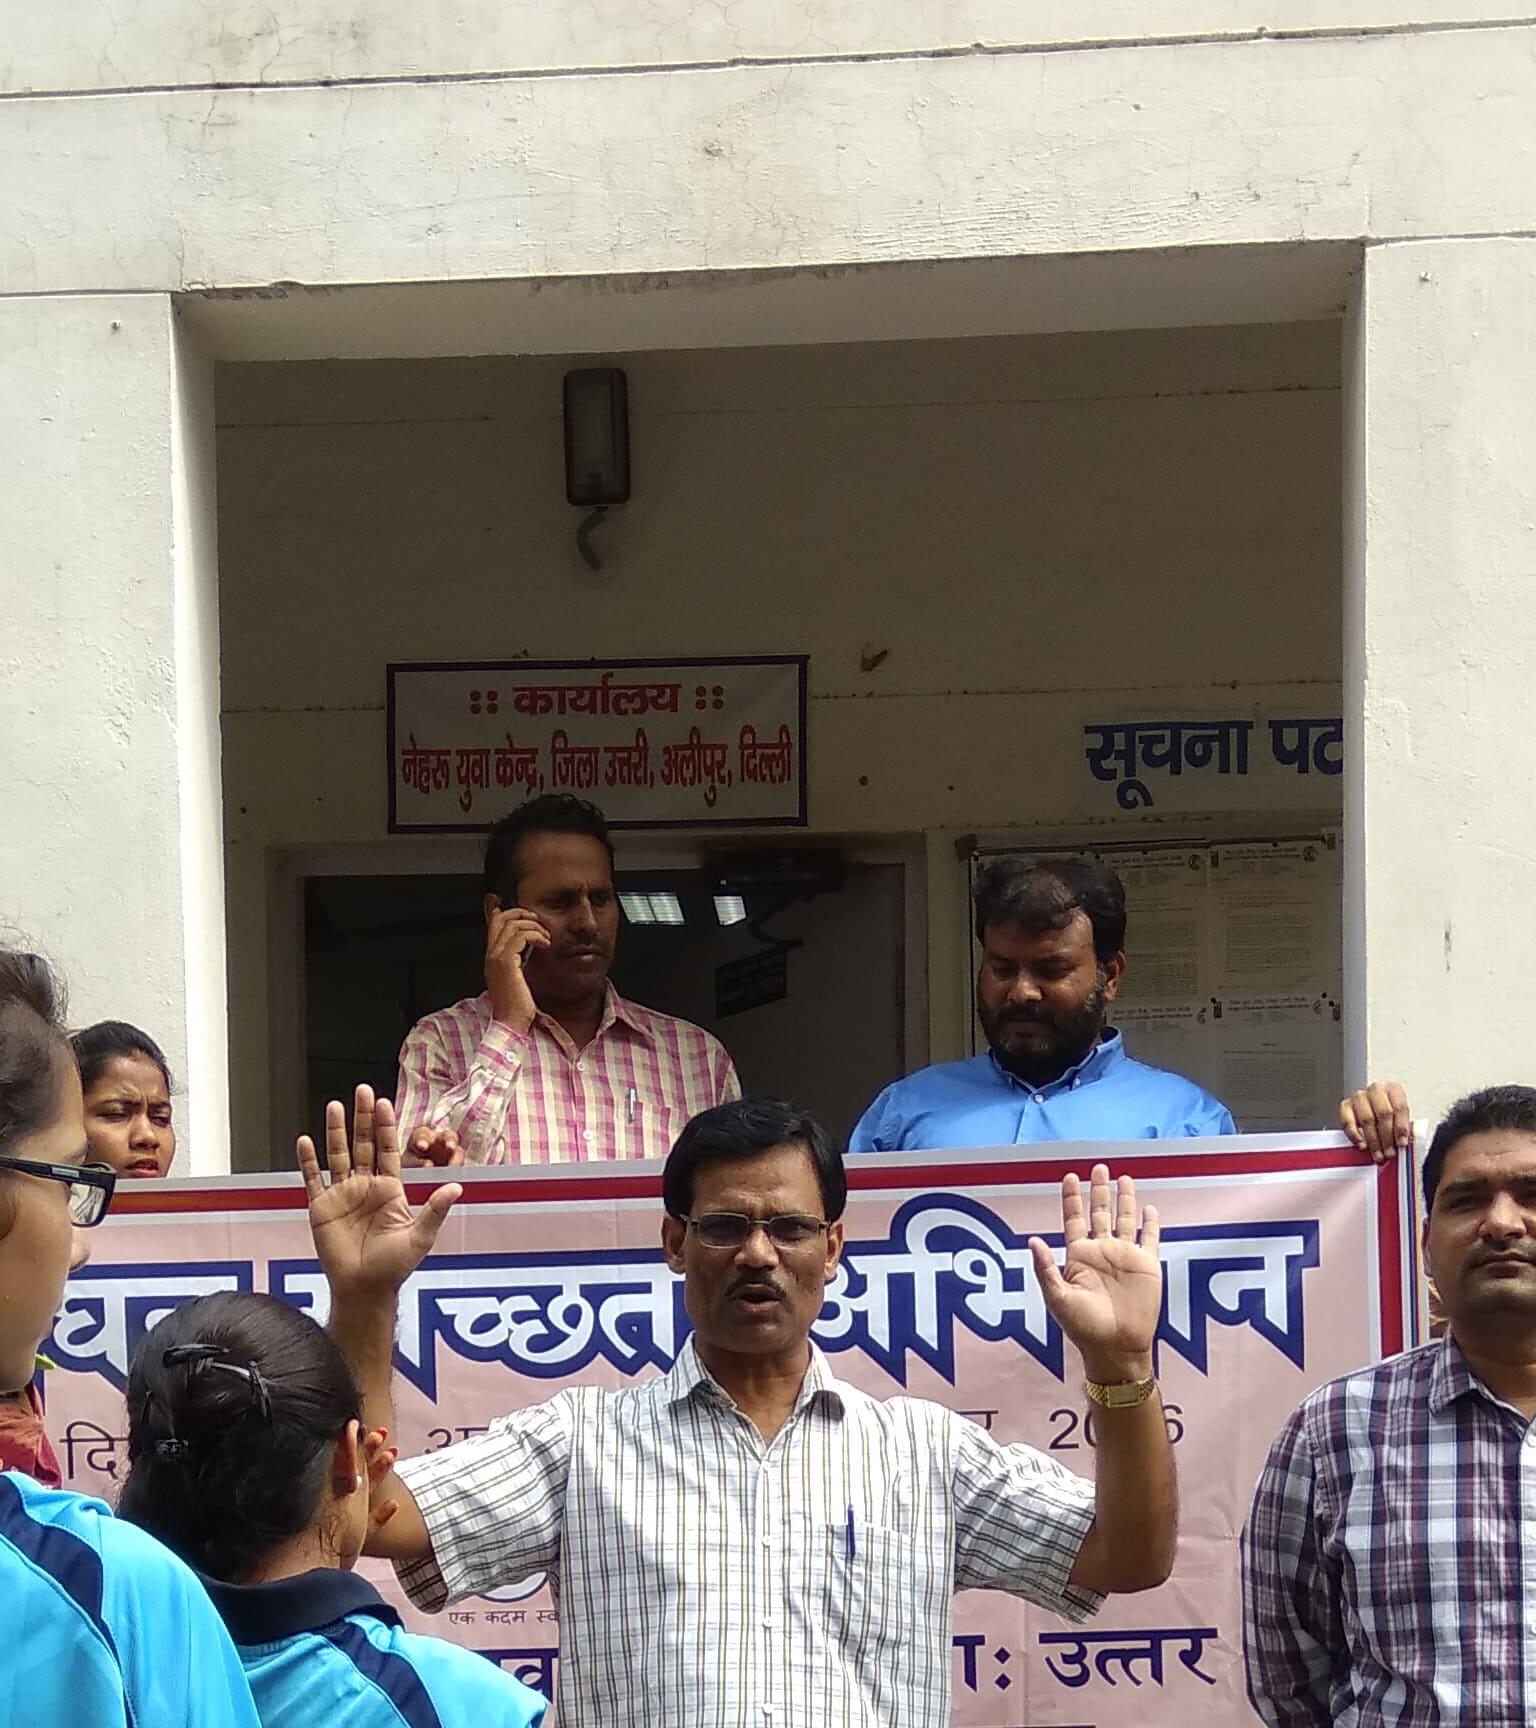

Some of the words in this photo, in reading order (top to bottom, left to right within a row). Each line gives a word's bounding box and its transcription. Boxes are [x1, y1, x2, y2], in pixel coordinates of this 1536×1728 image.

[512, 672, 682, 716] कार्यालय
[455, 747, 490, 812] युवा
[552, 729, 600, 789] जिला
[663, 726, 733, 808] अलीपुर,
[738, 723, 794, 786] दिल्ली
[1084, 719, 1254, 810] सूचना
[448, 1607, 475, 1626] एक
[484, 1607, 527, 1625] कदम
[1038, 1627, 1219, 1689] उत्तर
